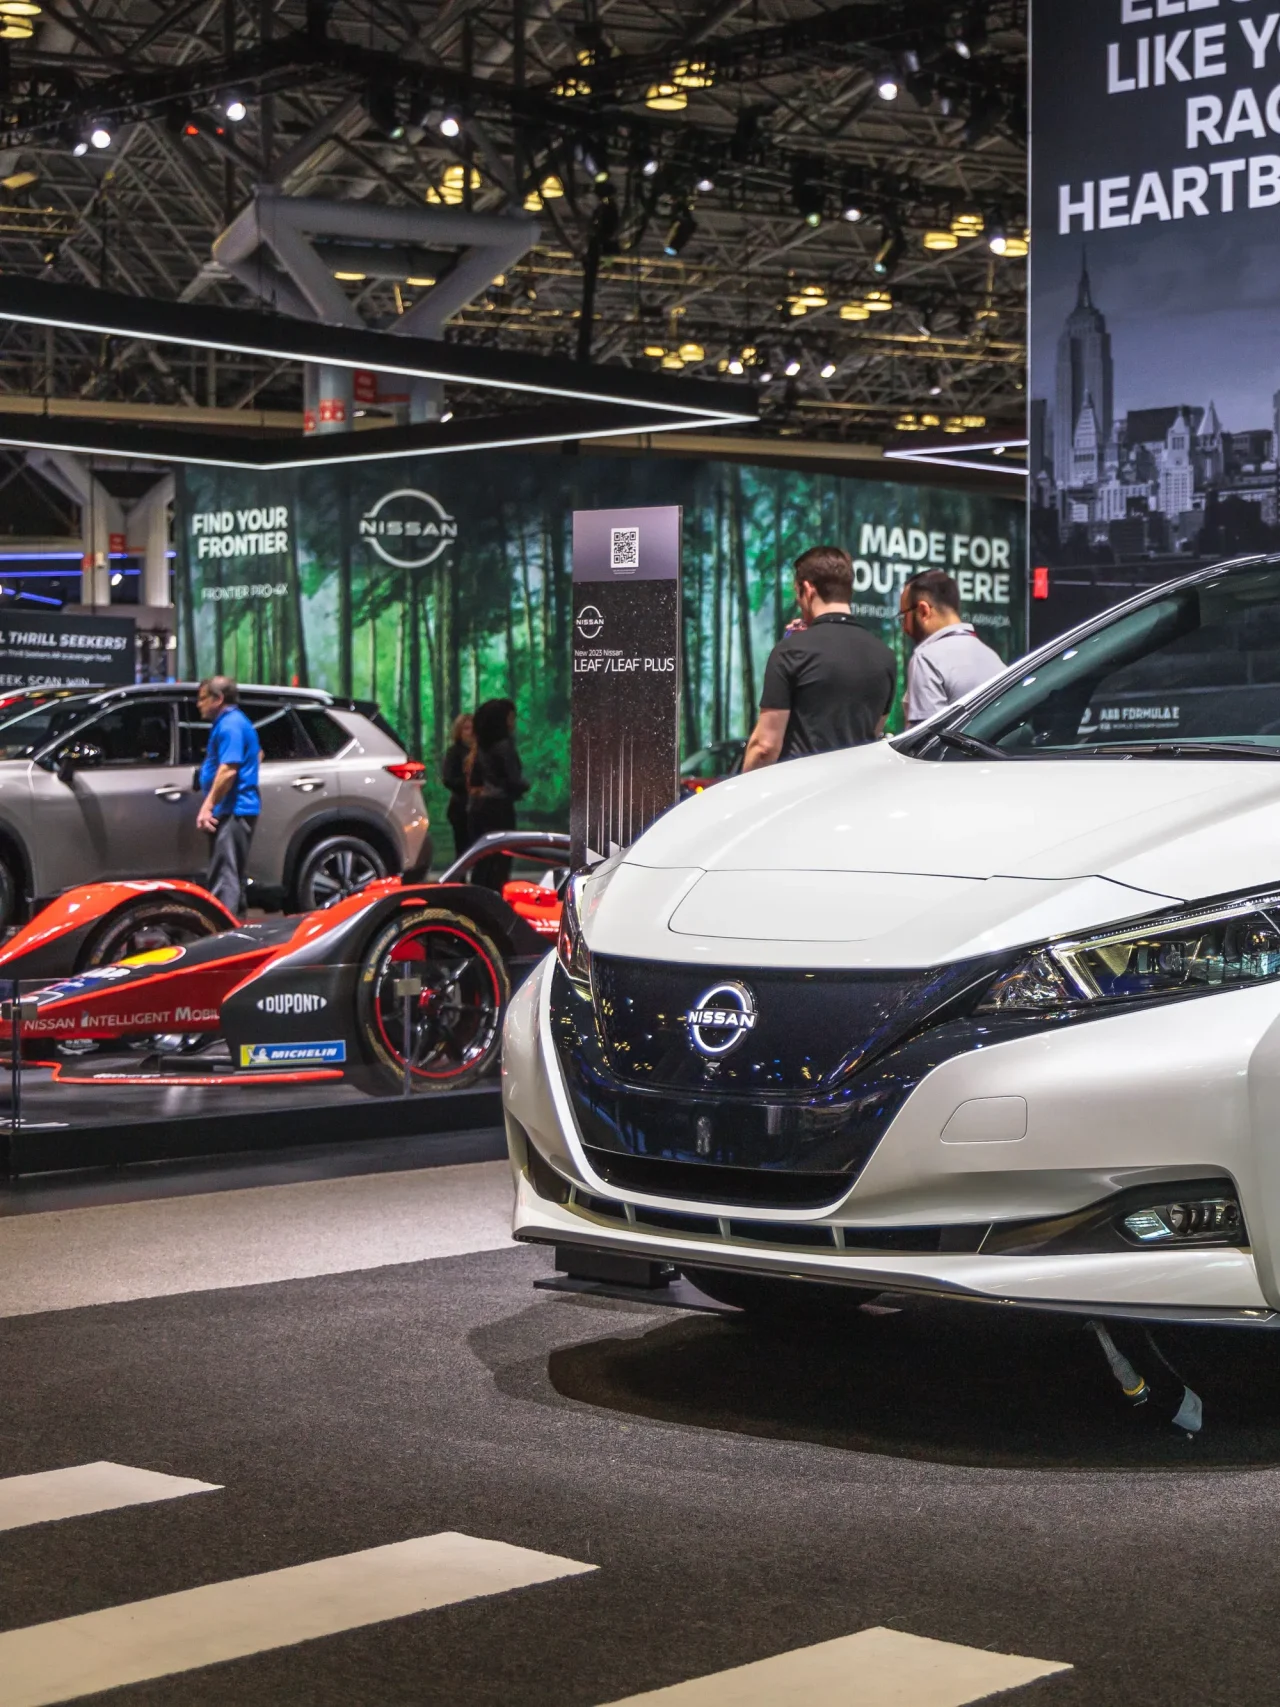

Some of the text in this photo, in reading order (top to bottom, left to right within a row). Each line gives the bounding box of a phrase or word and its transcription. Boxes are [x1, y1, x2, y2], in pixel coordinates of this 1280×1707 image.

[1107, 23, 1227, 95] LIKE
[191, 506, 288, 536] FIND YOUR
[359, 519, 458, 538] NISSAN
[198, 530, 288, 560] FRONTIER
[859, 523, 1011, 570] MADE FOR
[852, 560, 1011, 604] OUT ERE
[8, 630, 58, 647] THRILL
[59, 634, 128, 651] SEEKERS!
[574, 649, 588, 657] New
[644, 657, 675, 672] PLUS
[1122, 705, 1171, 720] FORMULA
[265, 993, 321, 1014] DUPONT
[24, 1005, 220, 1030] NISSAN INTELLIGENT MOBIL
[689, 1010, 755, 1028] NISSAN
[270, 1047, 338, 1060] MICHELIN
